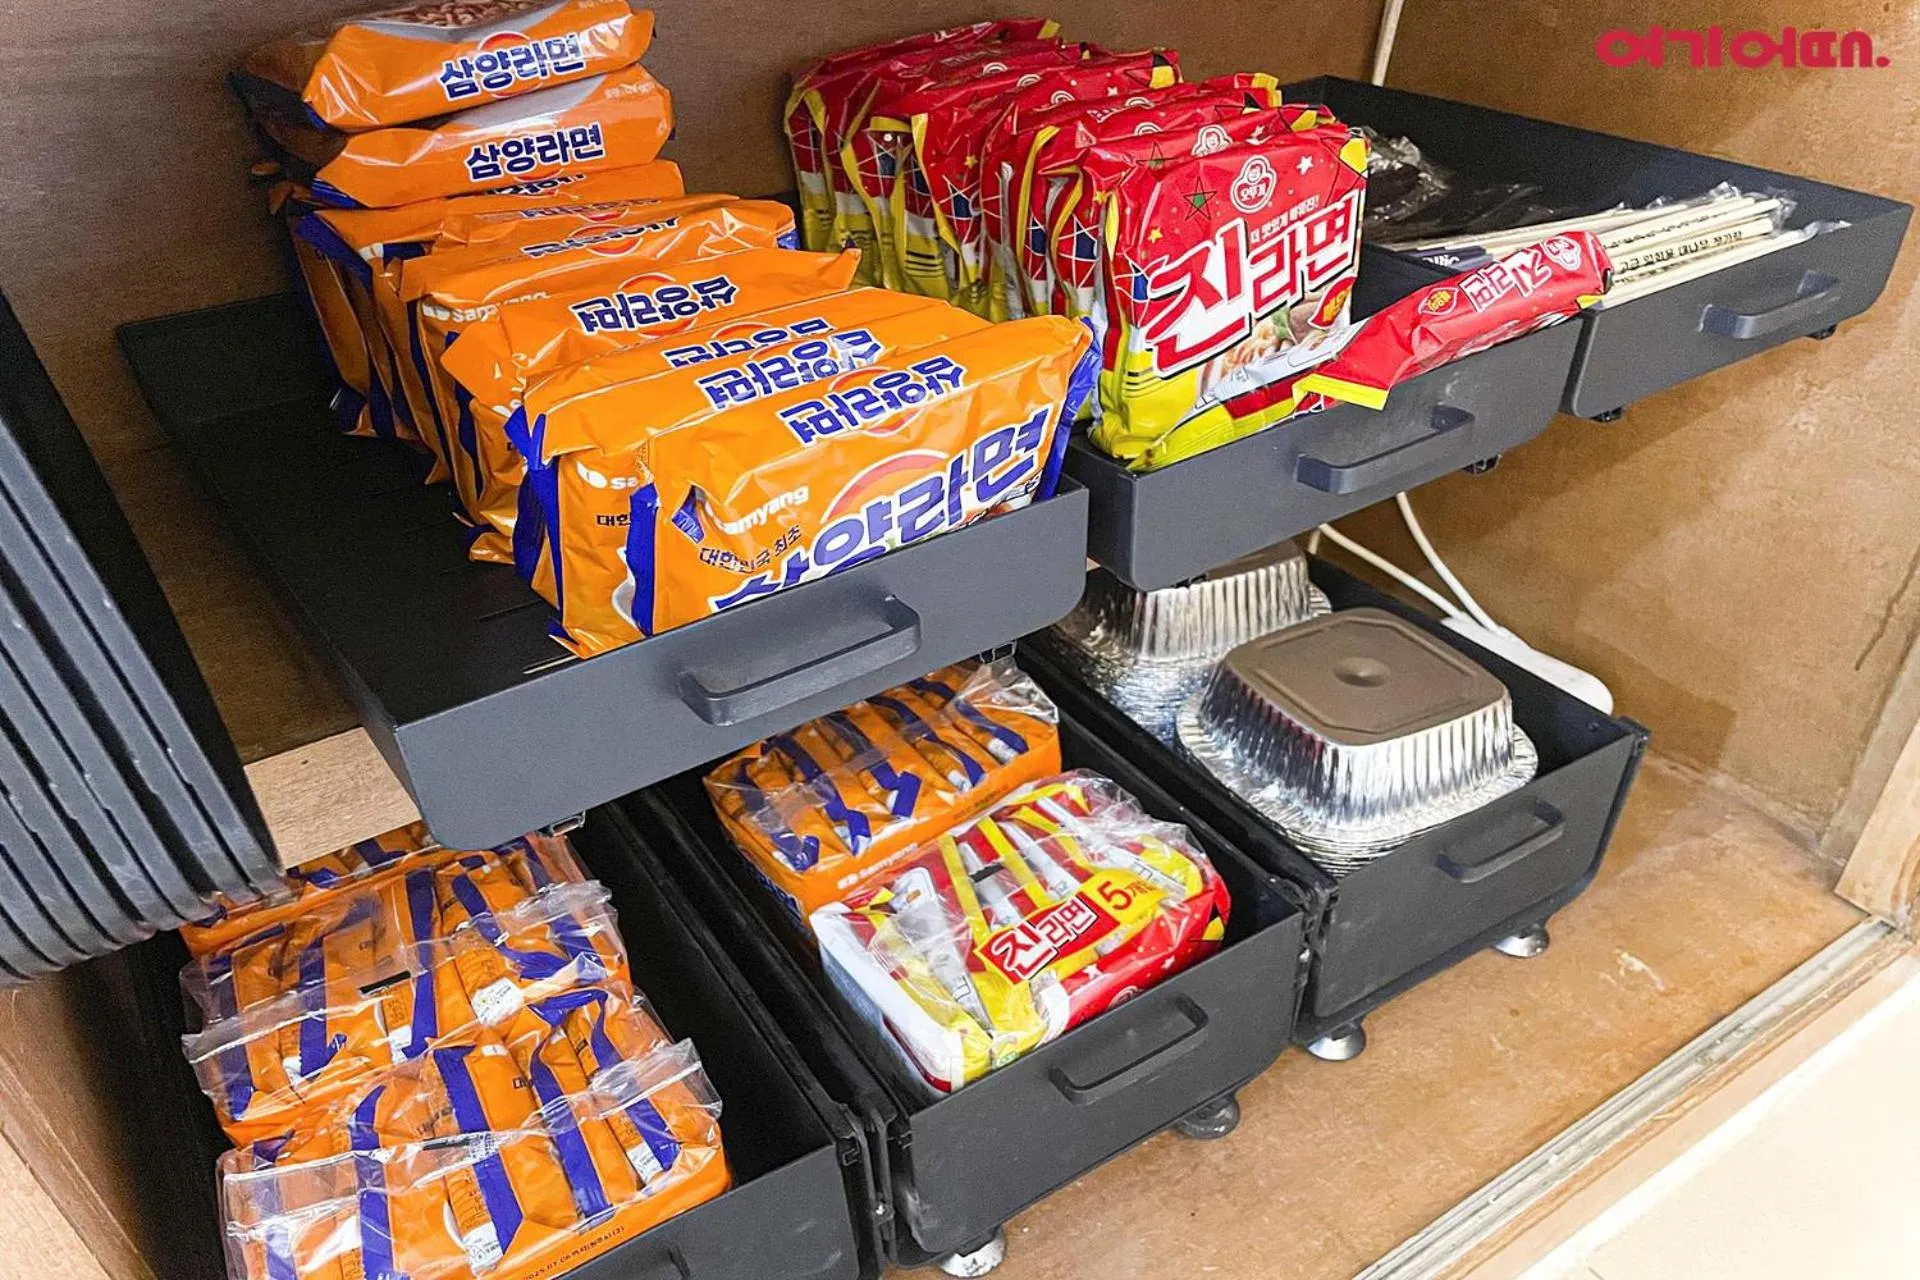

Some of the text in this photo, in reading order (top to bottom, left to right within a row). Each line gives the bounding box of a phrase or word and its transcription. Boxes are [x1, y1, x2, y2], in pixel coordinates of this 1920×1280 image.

[439, 32, 585, 100] 삼양라면
[465, 122, 606, 181] 삼양라면
[570, 276, 739, 333] 삼양라면
[1146, 190, 1358, 378] 진라면
[696, 330, 883, 410] 삼양라면
[777, 356, 967, 445] 삼양라면
[773, 525, 802, 557] 최초
[992, 897, 1098, 979] 진라면
